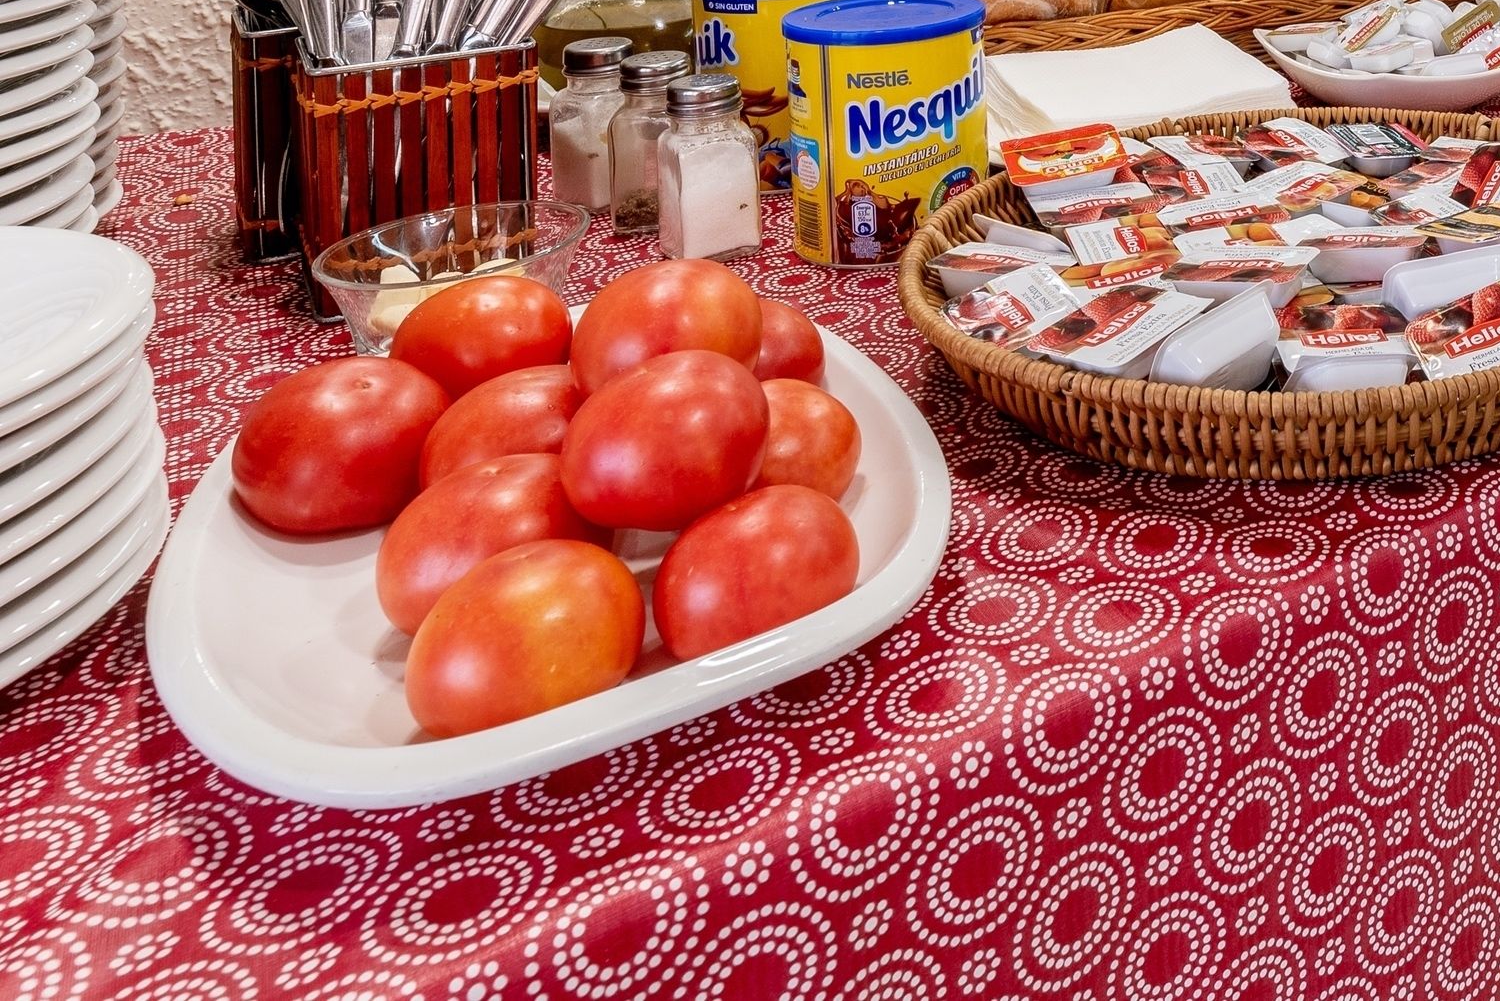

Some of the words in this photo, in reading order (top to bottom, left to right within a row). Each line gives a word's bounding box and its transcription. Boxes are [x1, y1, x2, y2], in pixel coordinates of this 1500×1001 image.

[726, 3, 754, 11] GLUTEN
[863, 143, 940, 176] INSTANTÁNEO
[879, 166, 913, 184] INCLUSO
[914, 163, 924, 174] EN
[926, 154, 946, 171] LECHE
[952, 172, 961, 181] VIT
[1186, 170, 1206, 196] Helios
[1064, 198, 1128, 214] Helios
[1191, 207, 1255, 225] Helios
[1120, 226, 1142, 253] Helios
[1204, 260, 1278, 269] Helios
[1093, 264, 1165, 288] Helios
[1084, 303, 1148, 345] Helios
[1116, 329, 1143, 347] Fresa
[1141, 313, 1167, 331] Extra
[1306, 332, 1381, 346] Helios
[1325, 347, 1366, 356] MERMELADA
[1468, 355, 1500, 372] Fresa
